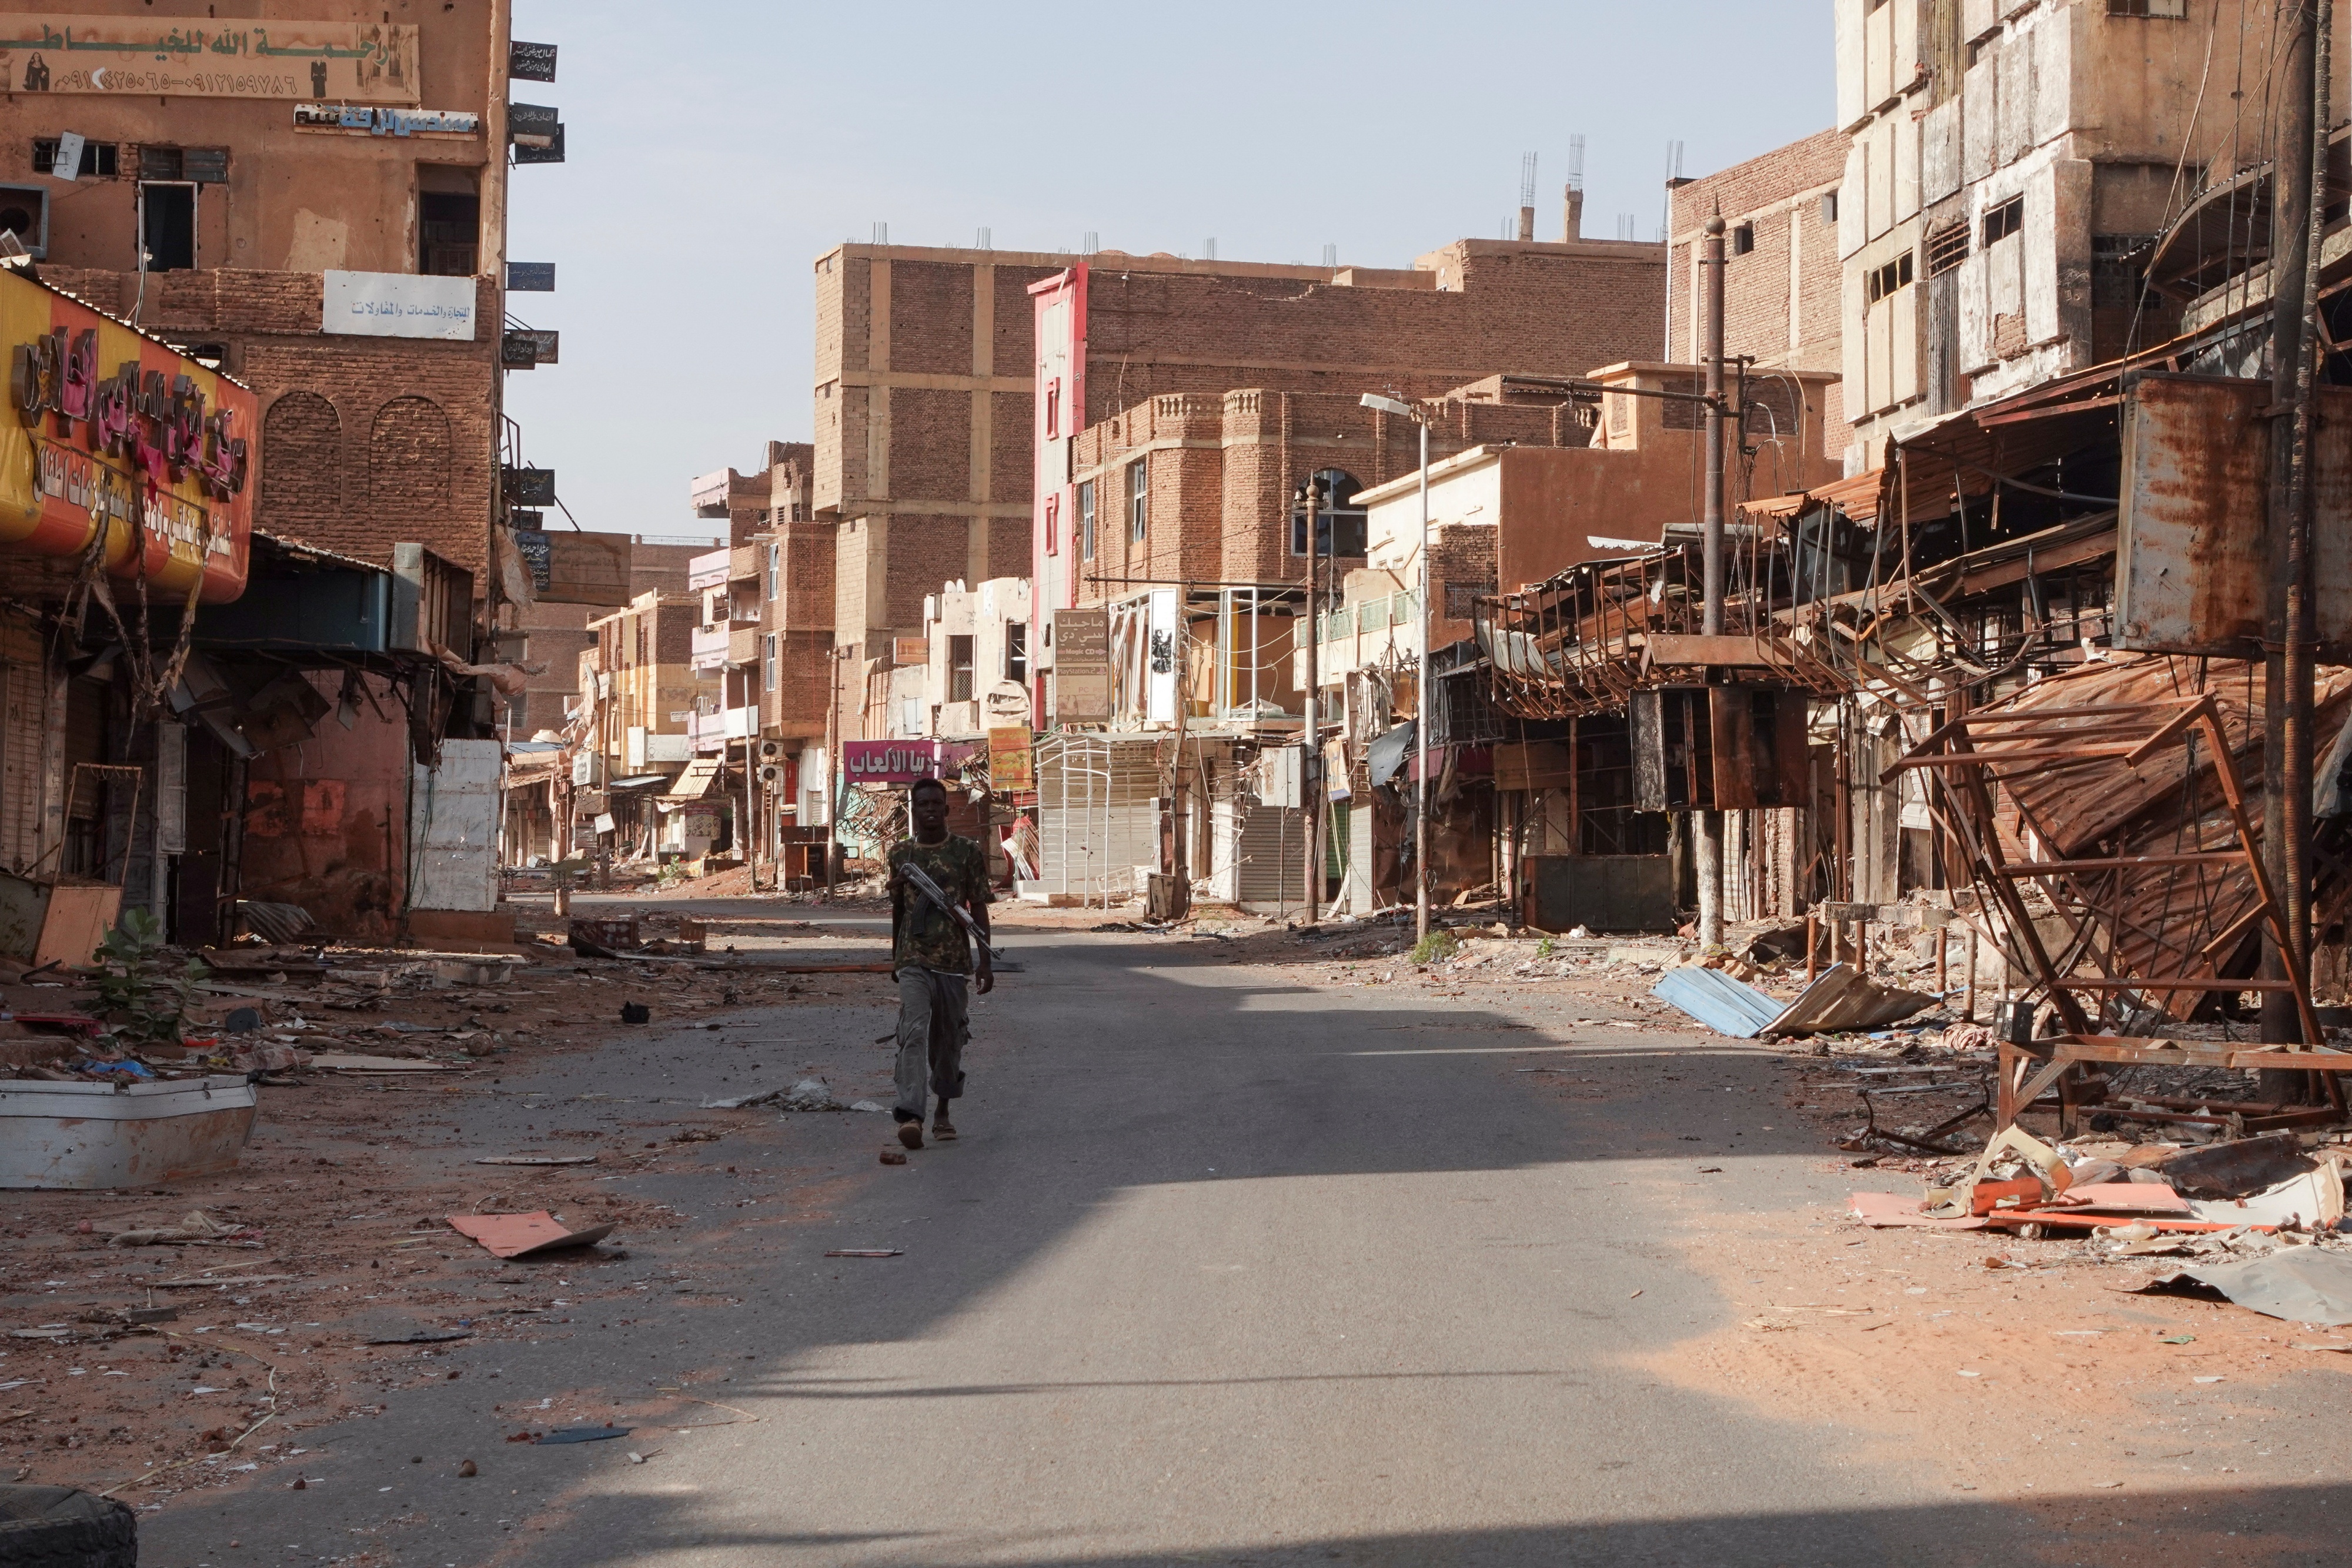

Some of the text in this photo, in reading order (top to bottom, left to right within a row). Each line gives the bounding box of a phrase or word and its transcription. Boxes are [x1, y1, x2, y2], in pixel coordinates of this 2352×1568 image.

[0, 24, 389, 66] رحمة الله للخياط
[351, 300, 403, 317] والمقاولات
[407, 305, 446, 319] والخدمات
[168, 503, 195, 557] بناتي
[535, 544, 549, 556] عثمان
[1059, 616, 1104, 631] ماجيك
[1059, 631, 1105, 646] سي دي
[850, 747, 935, 777] دنيا الألعاب
